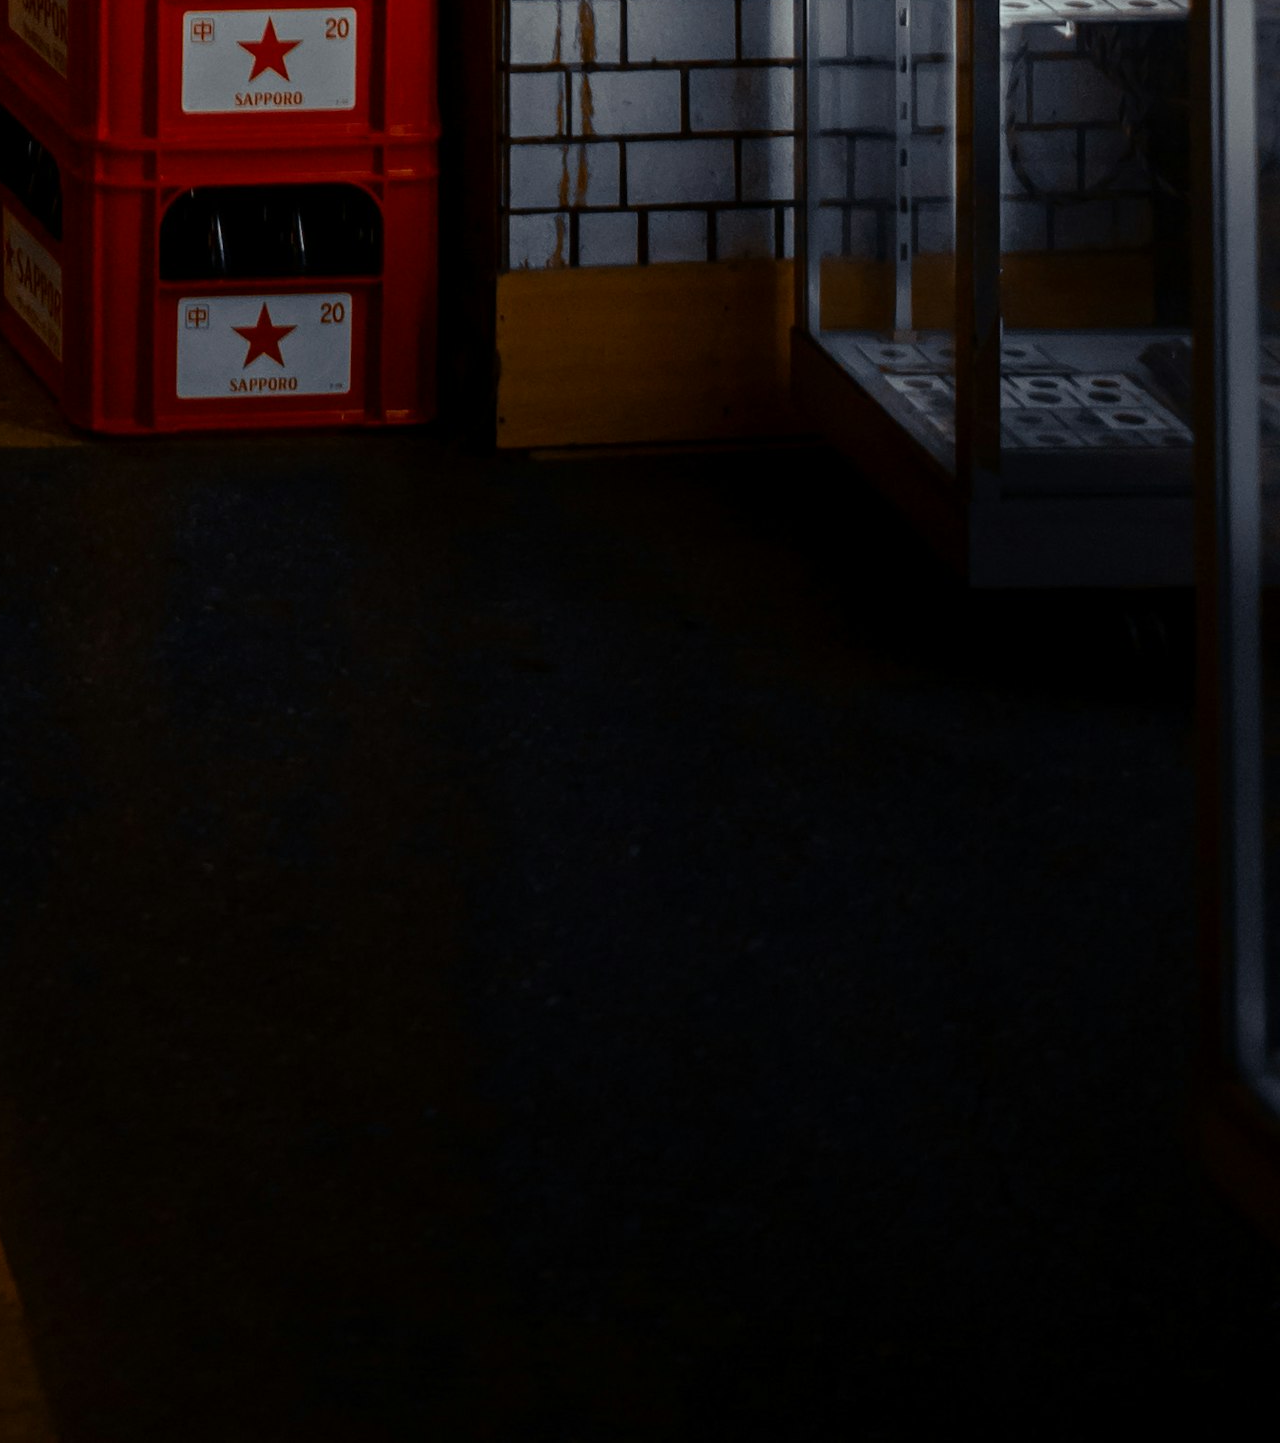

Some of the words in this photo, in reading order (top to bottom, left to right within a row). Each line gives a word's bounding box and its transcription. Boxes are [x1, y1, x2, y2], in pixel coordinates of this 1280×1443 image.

[325, 18, 350, 40] 20
[234, 91, 304, 106] SAPPORO
[320, 303, 345, 324] 20
[229, 377, 298, 392] SAPPORO
